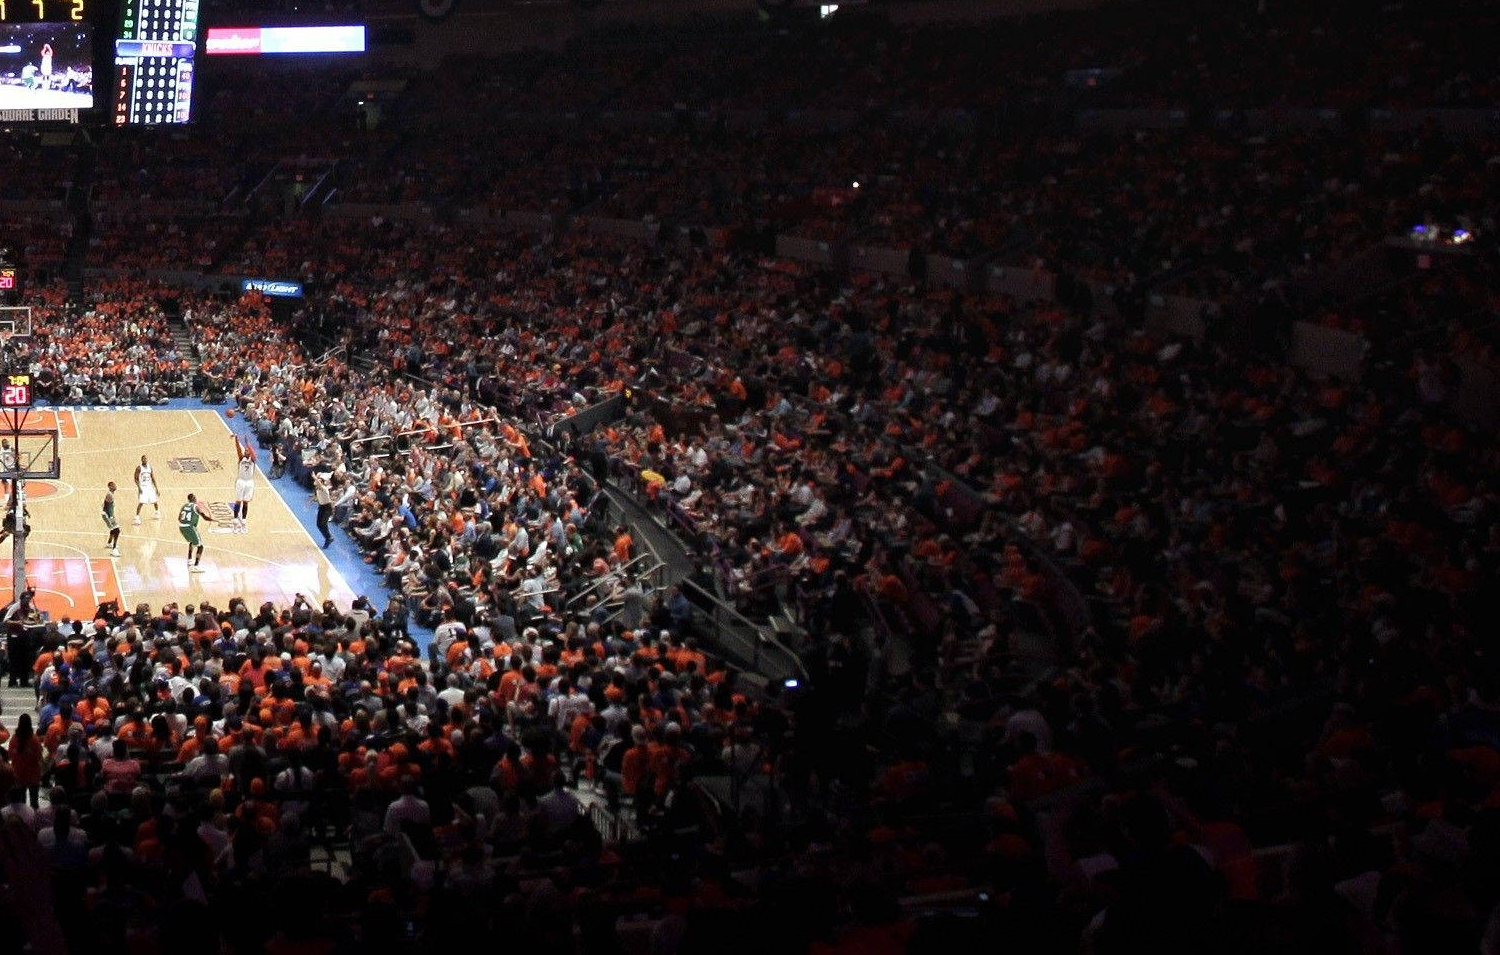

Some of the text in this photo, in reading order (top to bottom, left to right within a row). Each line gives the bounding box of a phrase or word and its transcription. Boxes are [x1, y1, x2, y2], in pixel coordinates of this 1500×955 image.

[72, 0, 85, 21] 2
[37, 108, 79, 124] GARDEN
[0, 277, 13, 289] 20
[8, 375, 30, 386] 7:09
[5, 386, 26, 405] 20
[180, 510, 192, 522] 34
